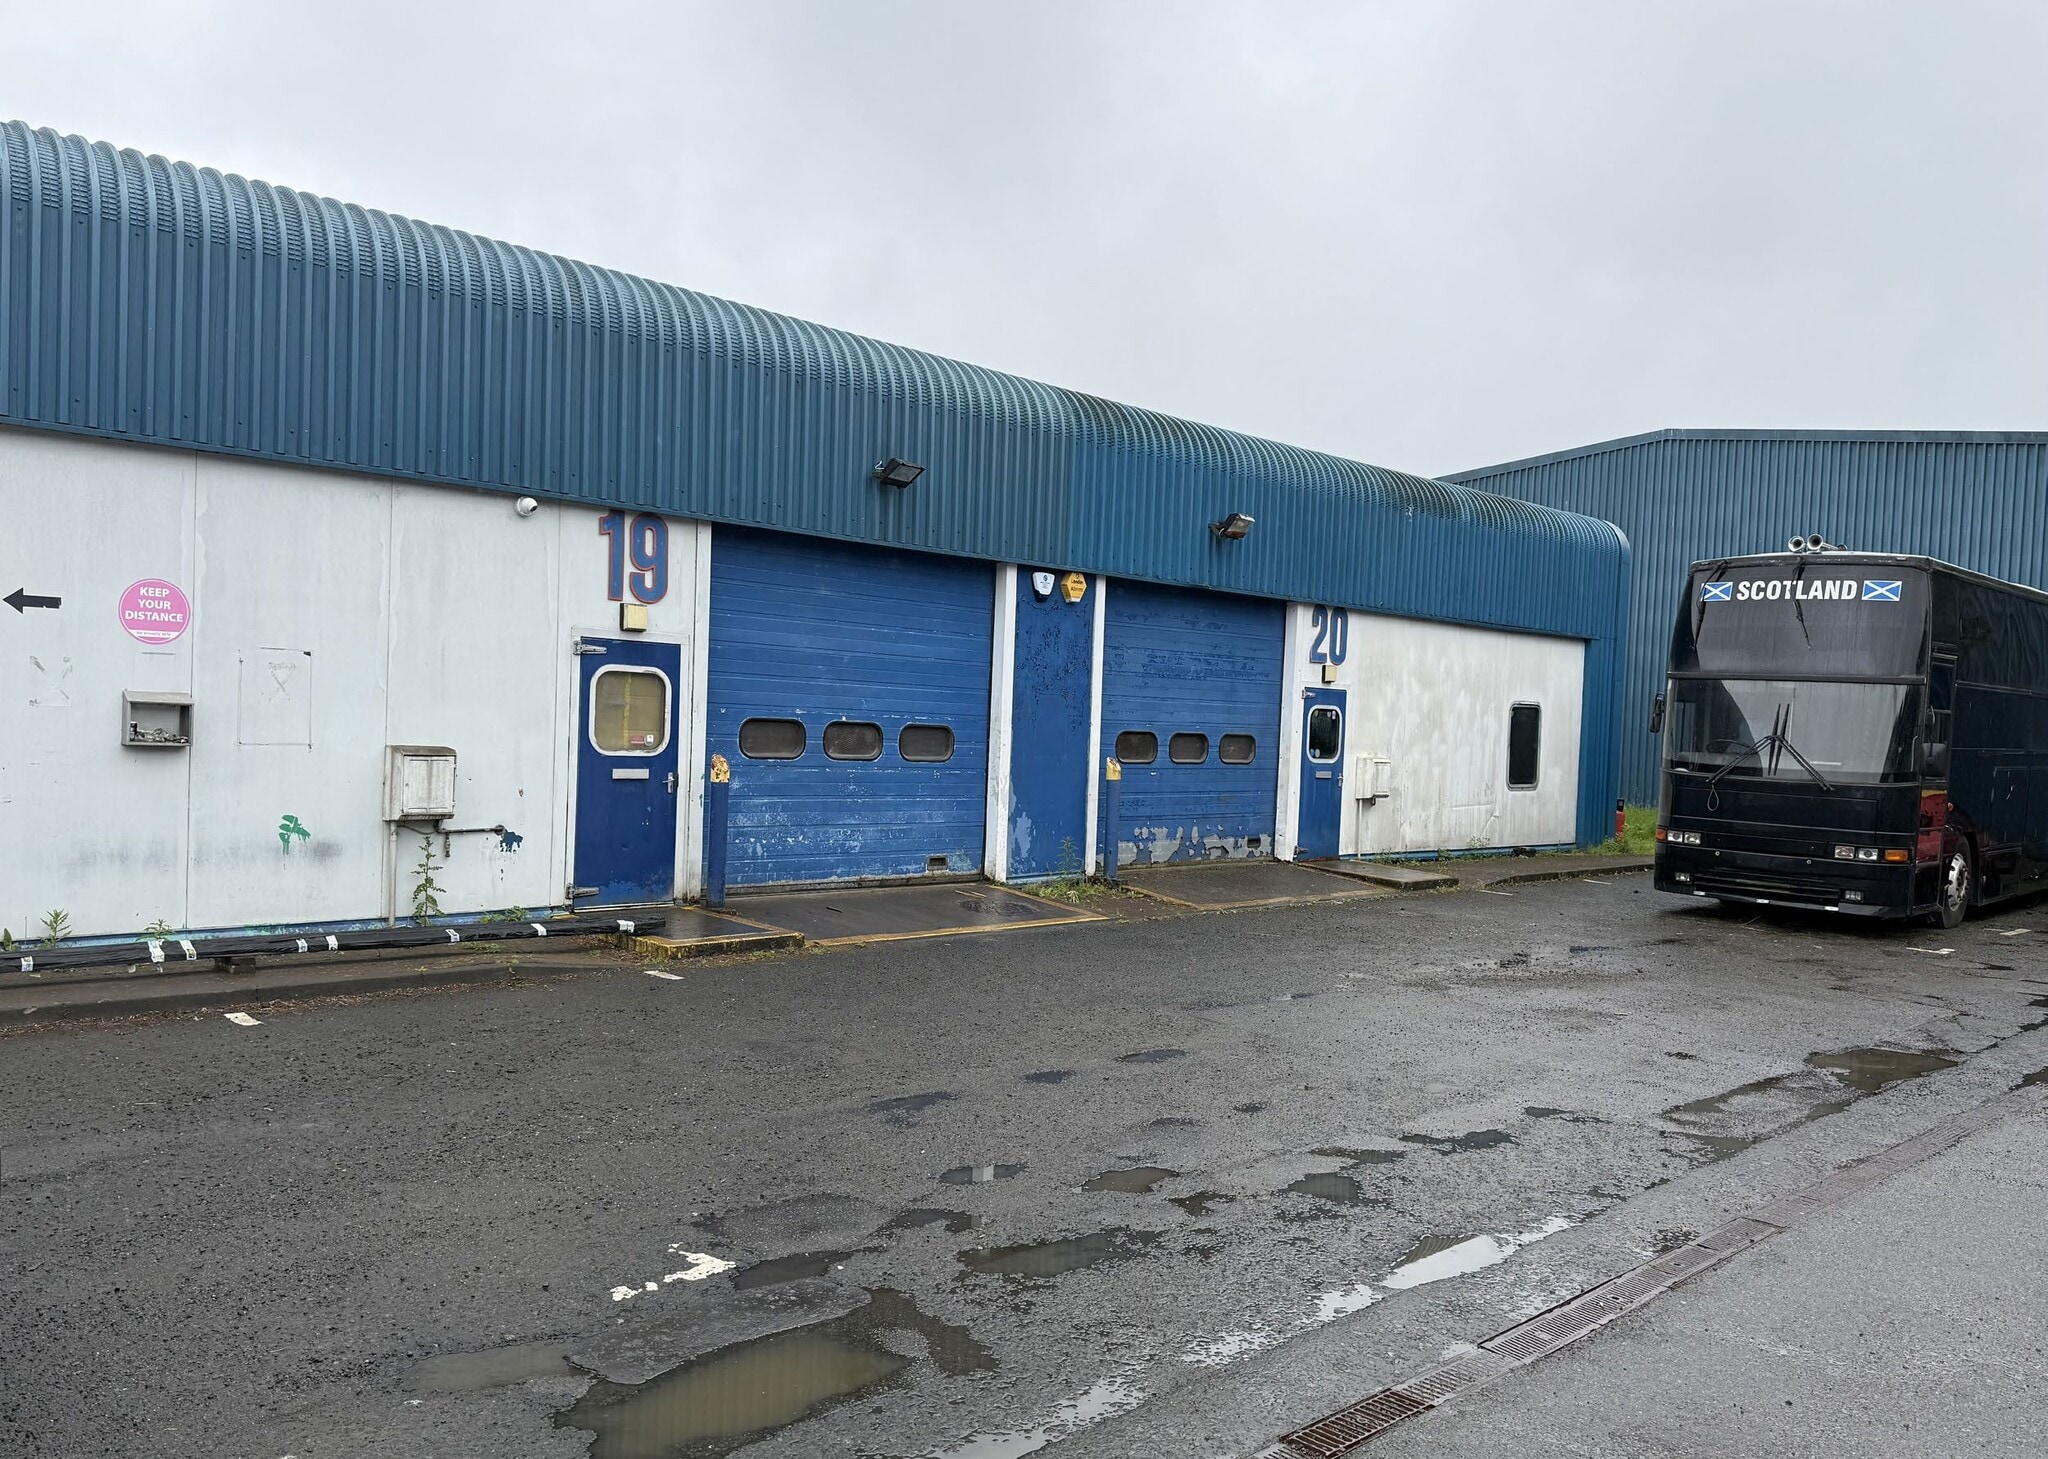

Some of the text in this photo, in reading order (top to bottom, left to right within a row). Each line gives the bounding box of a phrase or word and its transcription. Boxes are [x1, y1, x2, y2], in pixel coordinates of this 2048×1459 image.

[599, 509, 669, 604] 19
[140, 586, 170, 598] KEEP
[1736, 580, 1858, 601] SCOTLAND
[137, 598, 171, 610] YOUR
[124, 610, 184, 622] DISTANCE
[1309, 603, 1349, 667] 20
